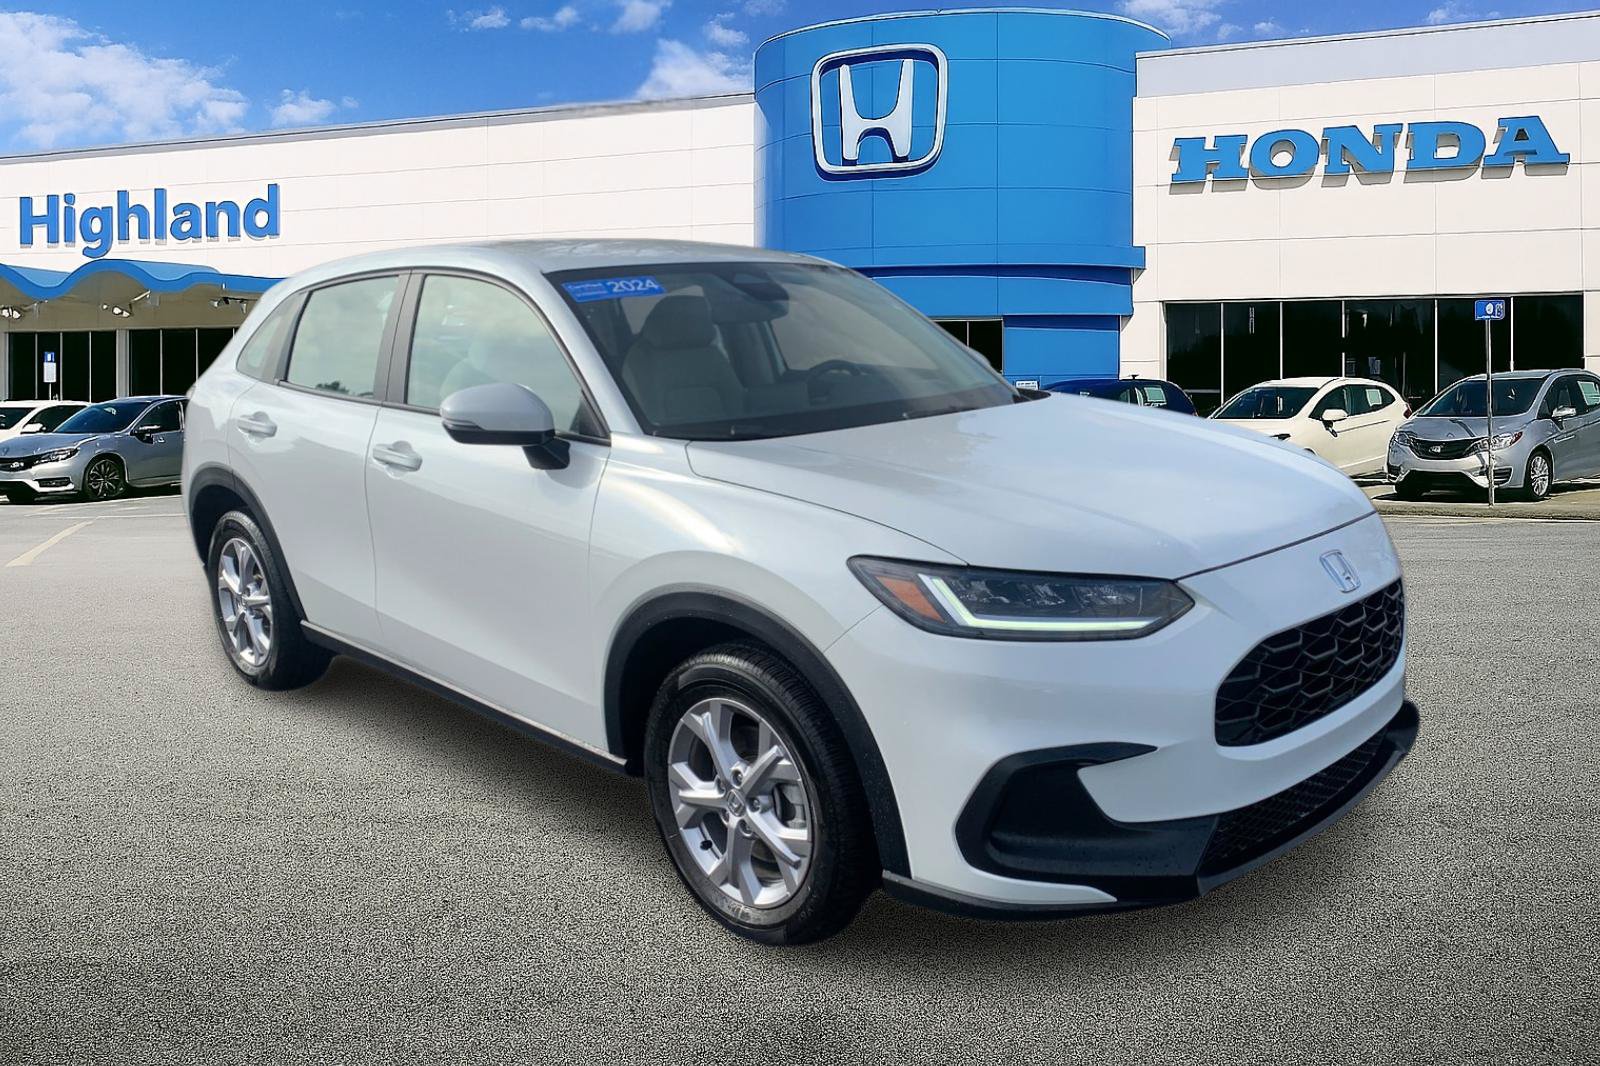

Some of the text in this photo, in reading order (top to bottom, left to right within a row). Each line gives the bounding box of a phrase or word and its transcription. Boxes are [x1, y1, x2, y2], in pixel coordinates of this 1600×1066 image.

[1171, 115, 1570, 183] HONDA
[19, 183, 281, 258] Highland
[606, 278, 659, 293] 2024
